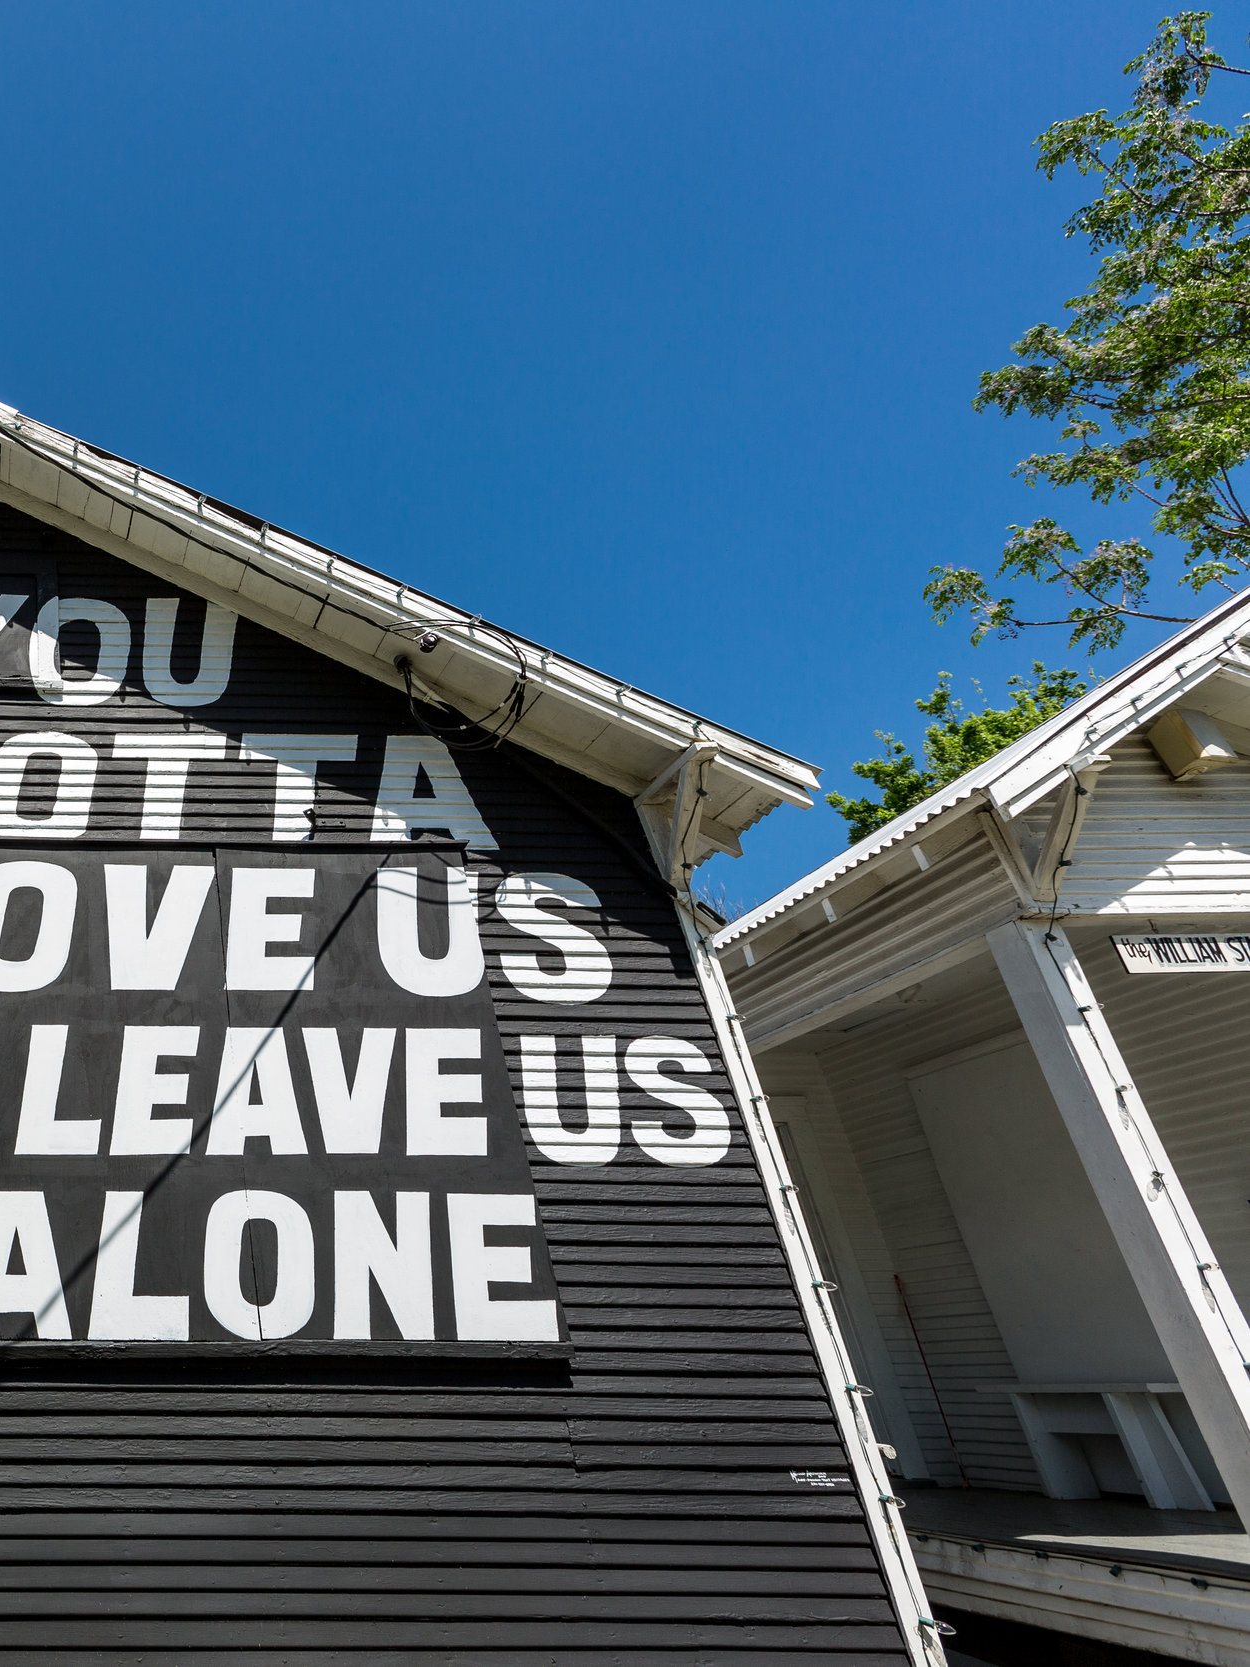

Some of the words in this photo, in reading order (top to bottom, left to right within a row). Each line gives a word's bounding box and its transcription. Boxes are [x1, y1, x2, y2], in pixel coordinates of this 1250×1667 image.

[376, 866, 614, 1002] US
[1122, 937, 1152, 964] the
[1149, 936, 1228, 963] WILLIAM
[14, 1025, 489, 1156] LEAVE
[522, 1034, 733, 1168] US
